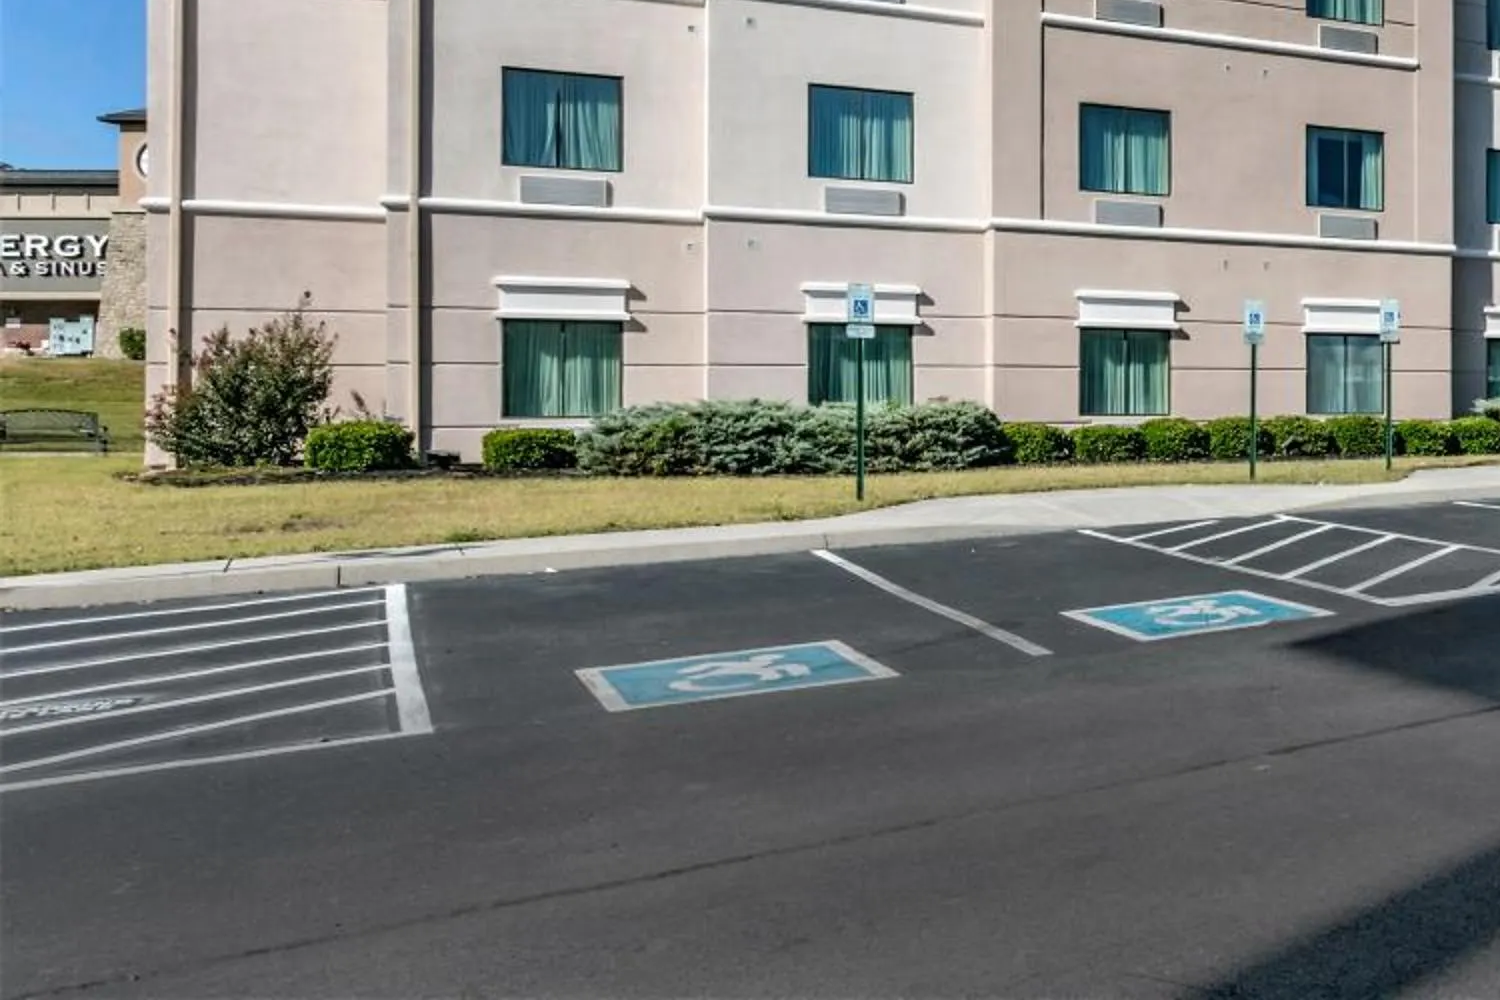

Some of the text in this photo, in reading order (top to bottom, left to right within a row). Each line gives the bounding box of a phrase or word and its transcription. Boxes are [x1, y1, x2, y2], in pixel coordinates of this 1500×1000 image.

[0, 234, 108, 257] ERGY
[10, 261, 107, 275] & SINUS
